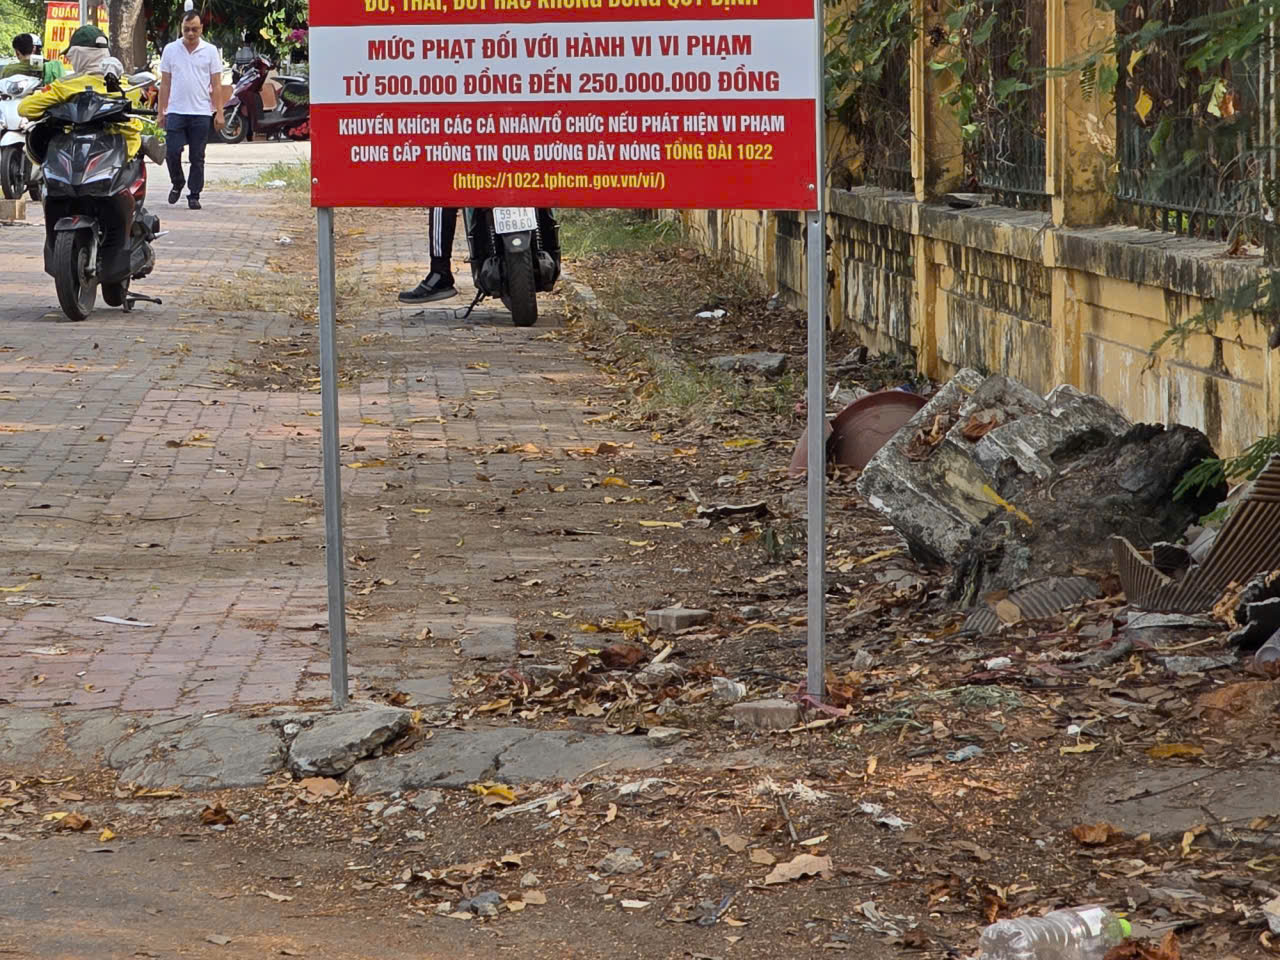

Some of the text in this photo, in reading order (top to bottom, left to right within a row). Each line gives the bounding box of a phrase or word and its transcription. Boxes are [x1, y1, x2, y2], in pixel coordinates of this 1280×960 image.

[368, 33, 751, 63] MỨC PHẠT ĐỐI VỚI HÀNH VI VI PHẠM
[343, 64, 779, 96] TỪ 500.000 ĐỒNG ĐẾN 250.000.000 ĐỒNG
[339, 111, 784, 135] KHUYẾN KHÍCH CÁC CÁ NHÂN/TỔ CHỨC NẾU PHÁT HIỆN VI PHẠM
[351, 139, 772, 163] CUNG CẤP THÔNG TIN QUA ĐƯỜNG DÂY NÓNG TỔNG ĐÀI 1022
[454, 172, 664, 190] (https://1022.tphcm.gov.vn/vi/)
